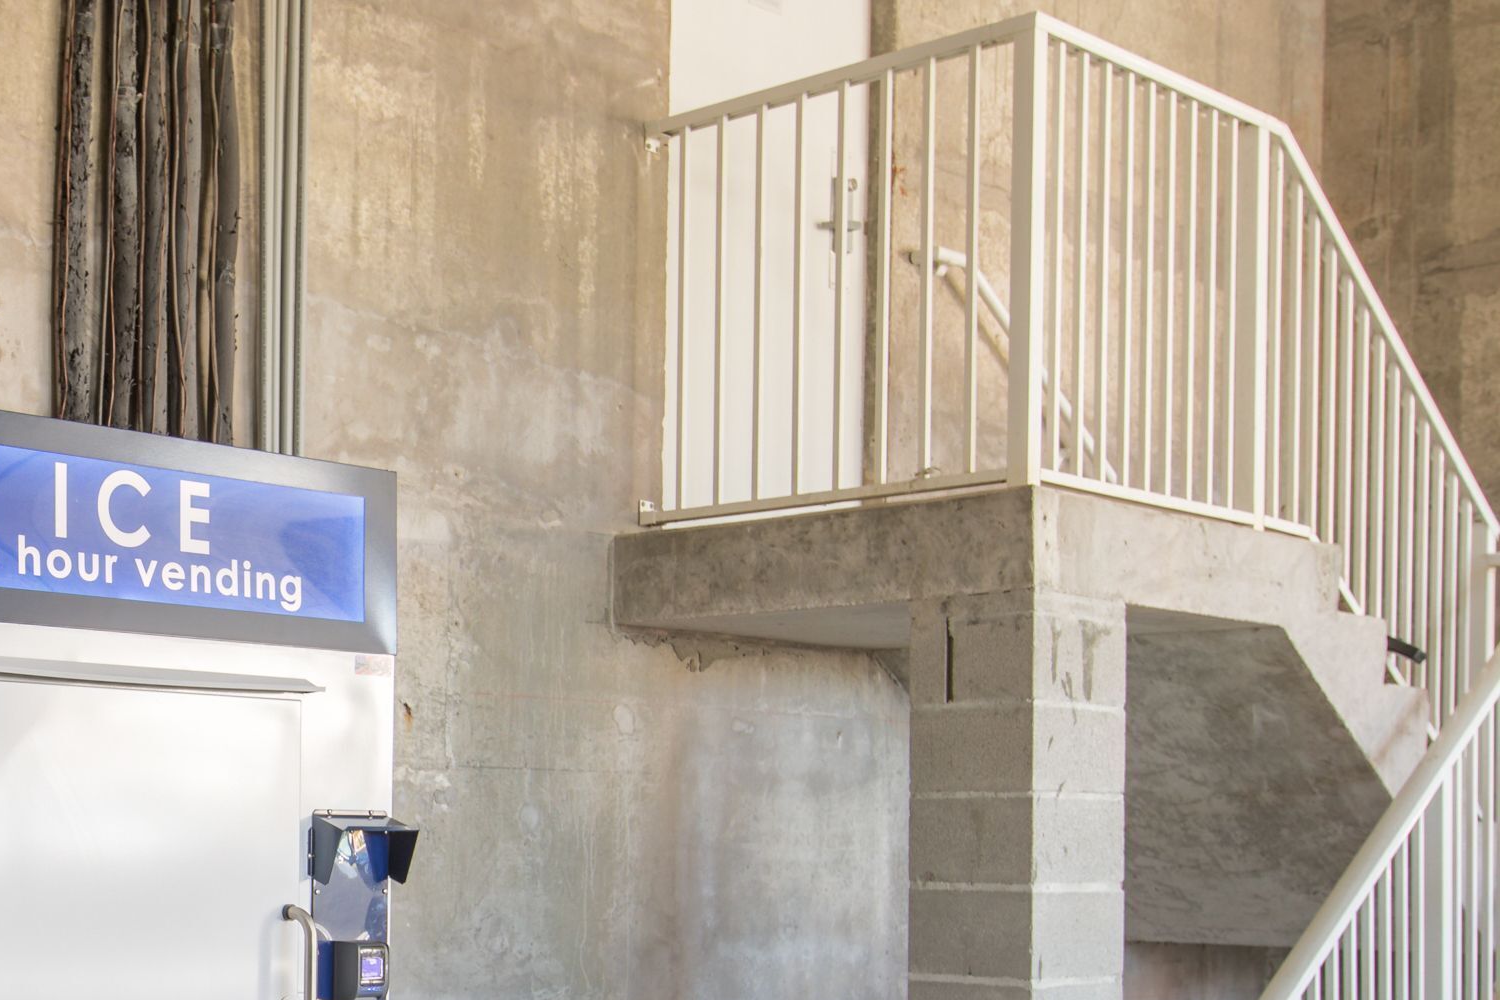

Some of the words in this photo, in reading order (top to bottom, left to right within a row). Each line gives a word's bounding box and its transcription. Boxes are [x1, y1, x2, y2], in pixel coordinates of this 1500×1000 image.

[55, 462, 211, 555] ICE
[18, 534, 118, 584] hour
[134, 559, 302, 612] vending
